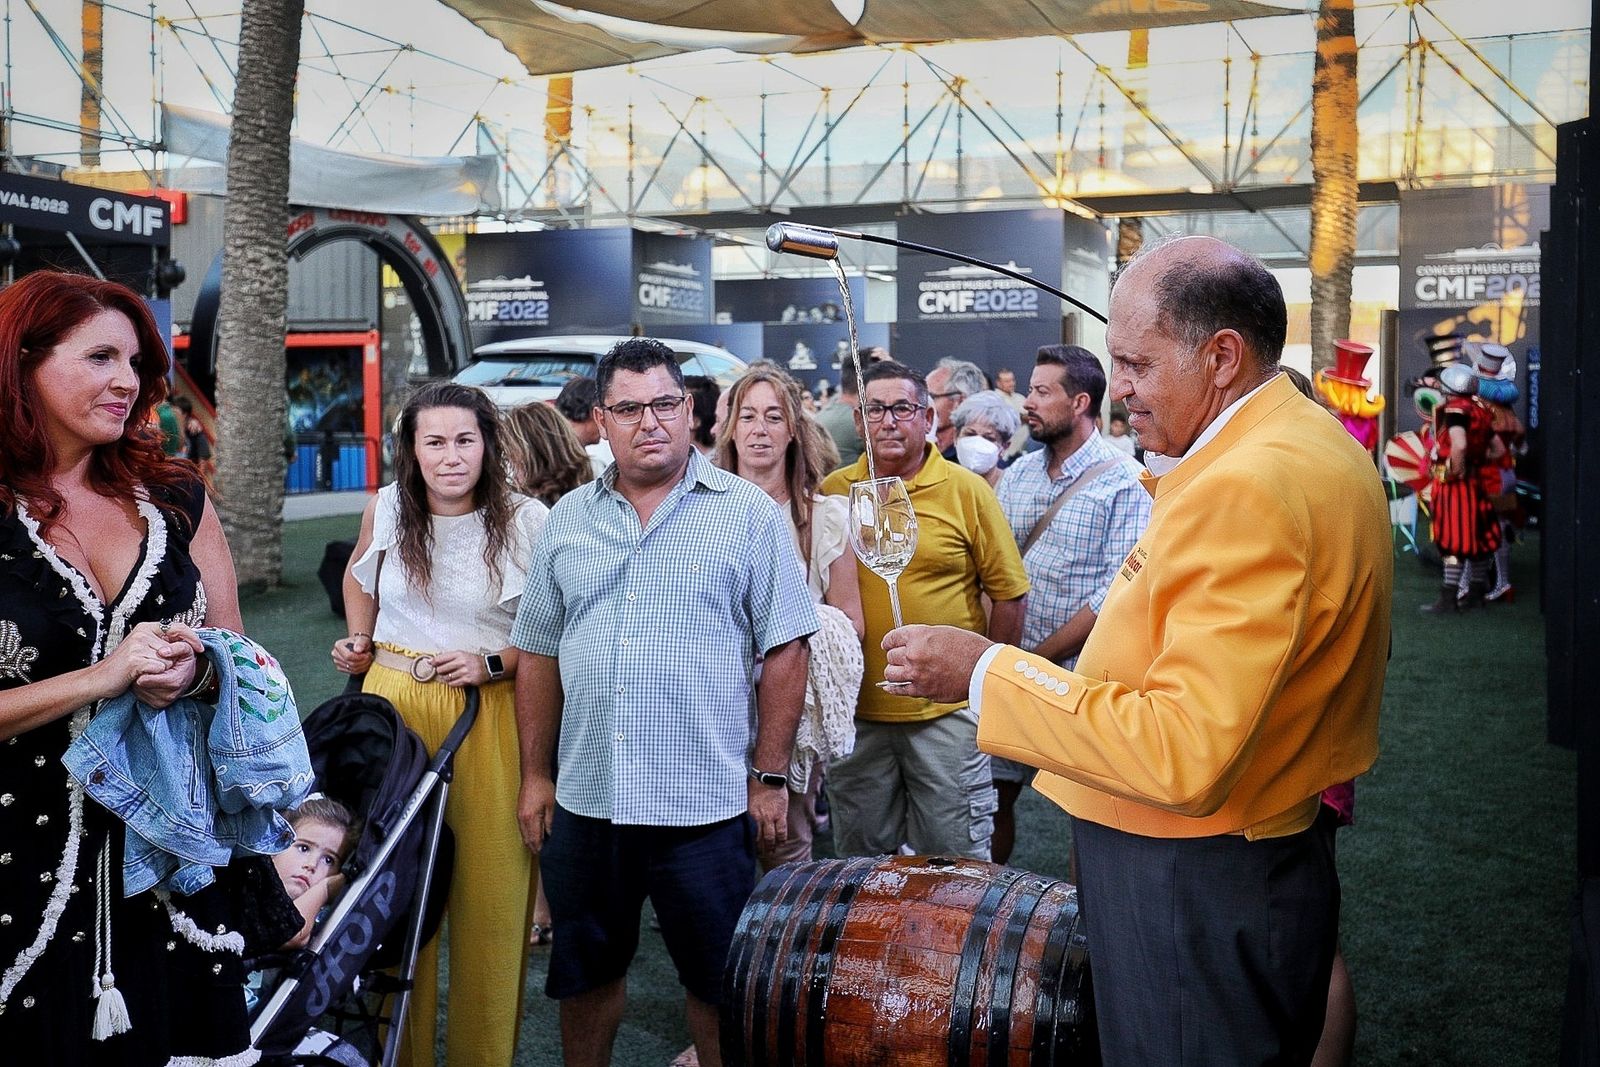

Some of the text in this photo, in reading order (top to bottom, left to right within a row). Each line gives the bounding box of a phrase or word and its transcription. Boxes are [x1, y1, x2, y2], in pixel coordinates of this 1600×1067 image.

[30, 195, 69, 215] 2022
[88, 197, 163, 236] CMF
[1416, 262, 1540, 276] CONCERT MUSIC FEST
[1415, 275, 1540, 301] CMF202
[468, 300, 549, 321] MF2022
[918, 289, 1038, 313] CMF2022
